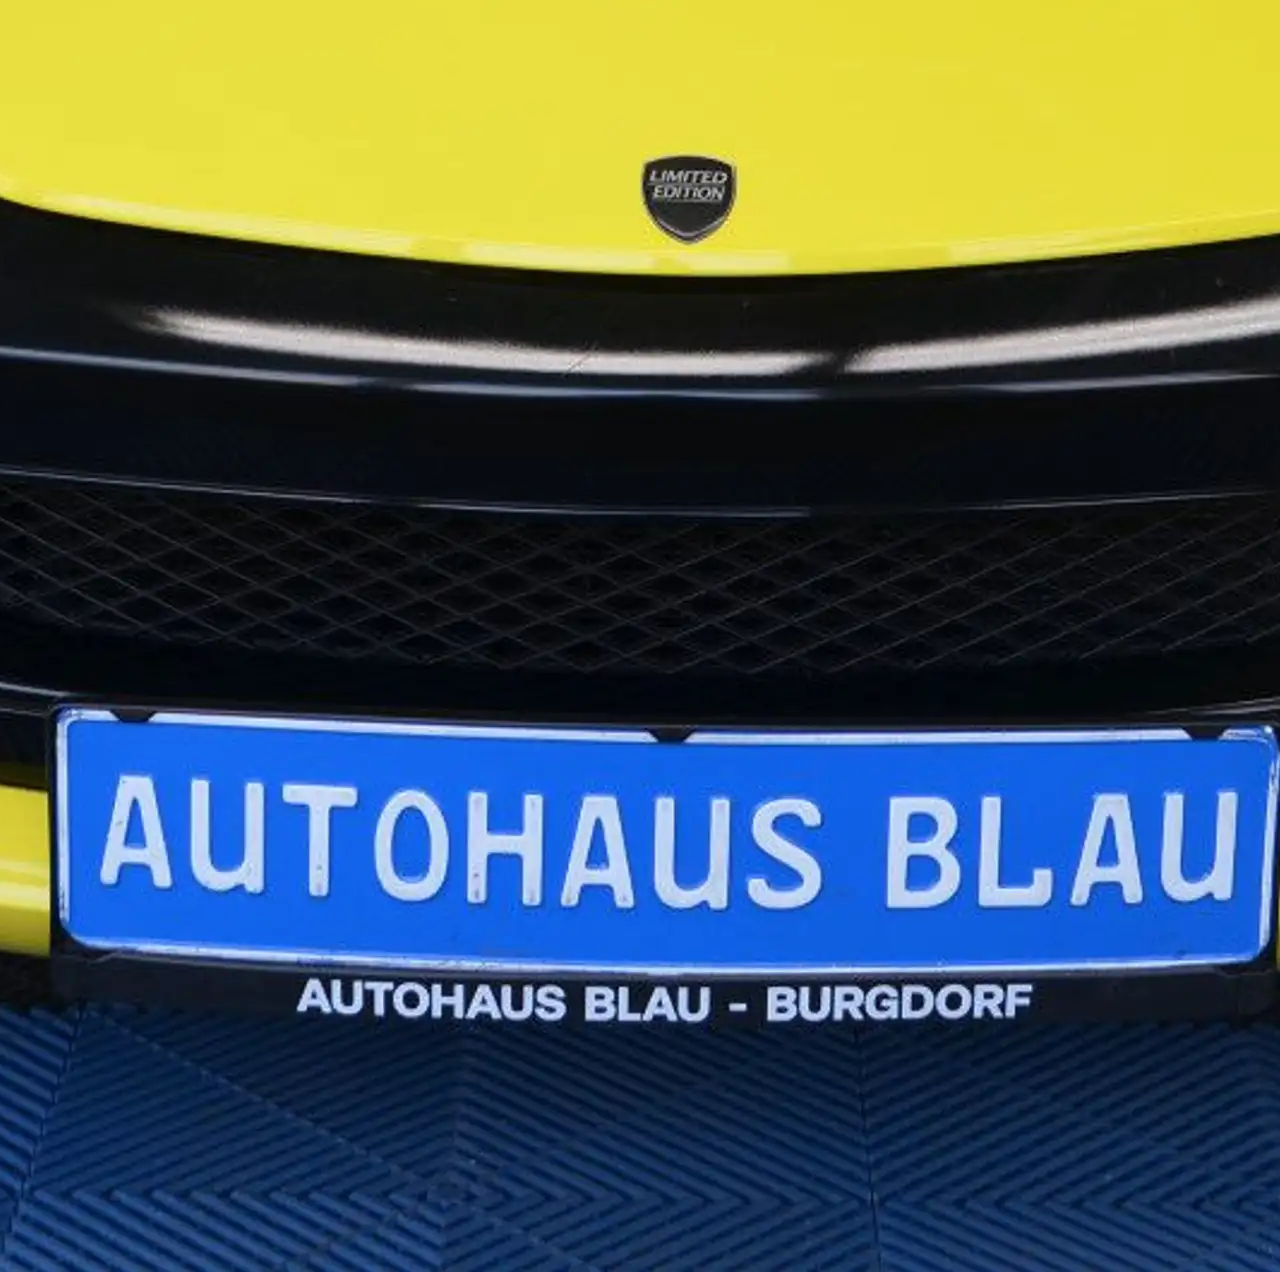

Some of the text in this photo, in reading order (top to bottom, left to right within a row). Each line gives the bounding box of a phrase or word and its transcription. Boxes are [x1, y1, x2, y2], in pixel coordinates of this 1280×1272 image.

[650, 170, 728, 184] LIMITED
[654, 185, 725, 200] EDITION
[100, 775, 1237, 910] AUTOHAUS BLAU
[296, 978, 566, 1021] AUTOHAUS
[585, 985, 710, 1022] BLAU
[767, 984, 1033, 1021] BURGDORF
